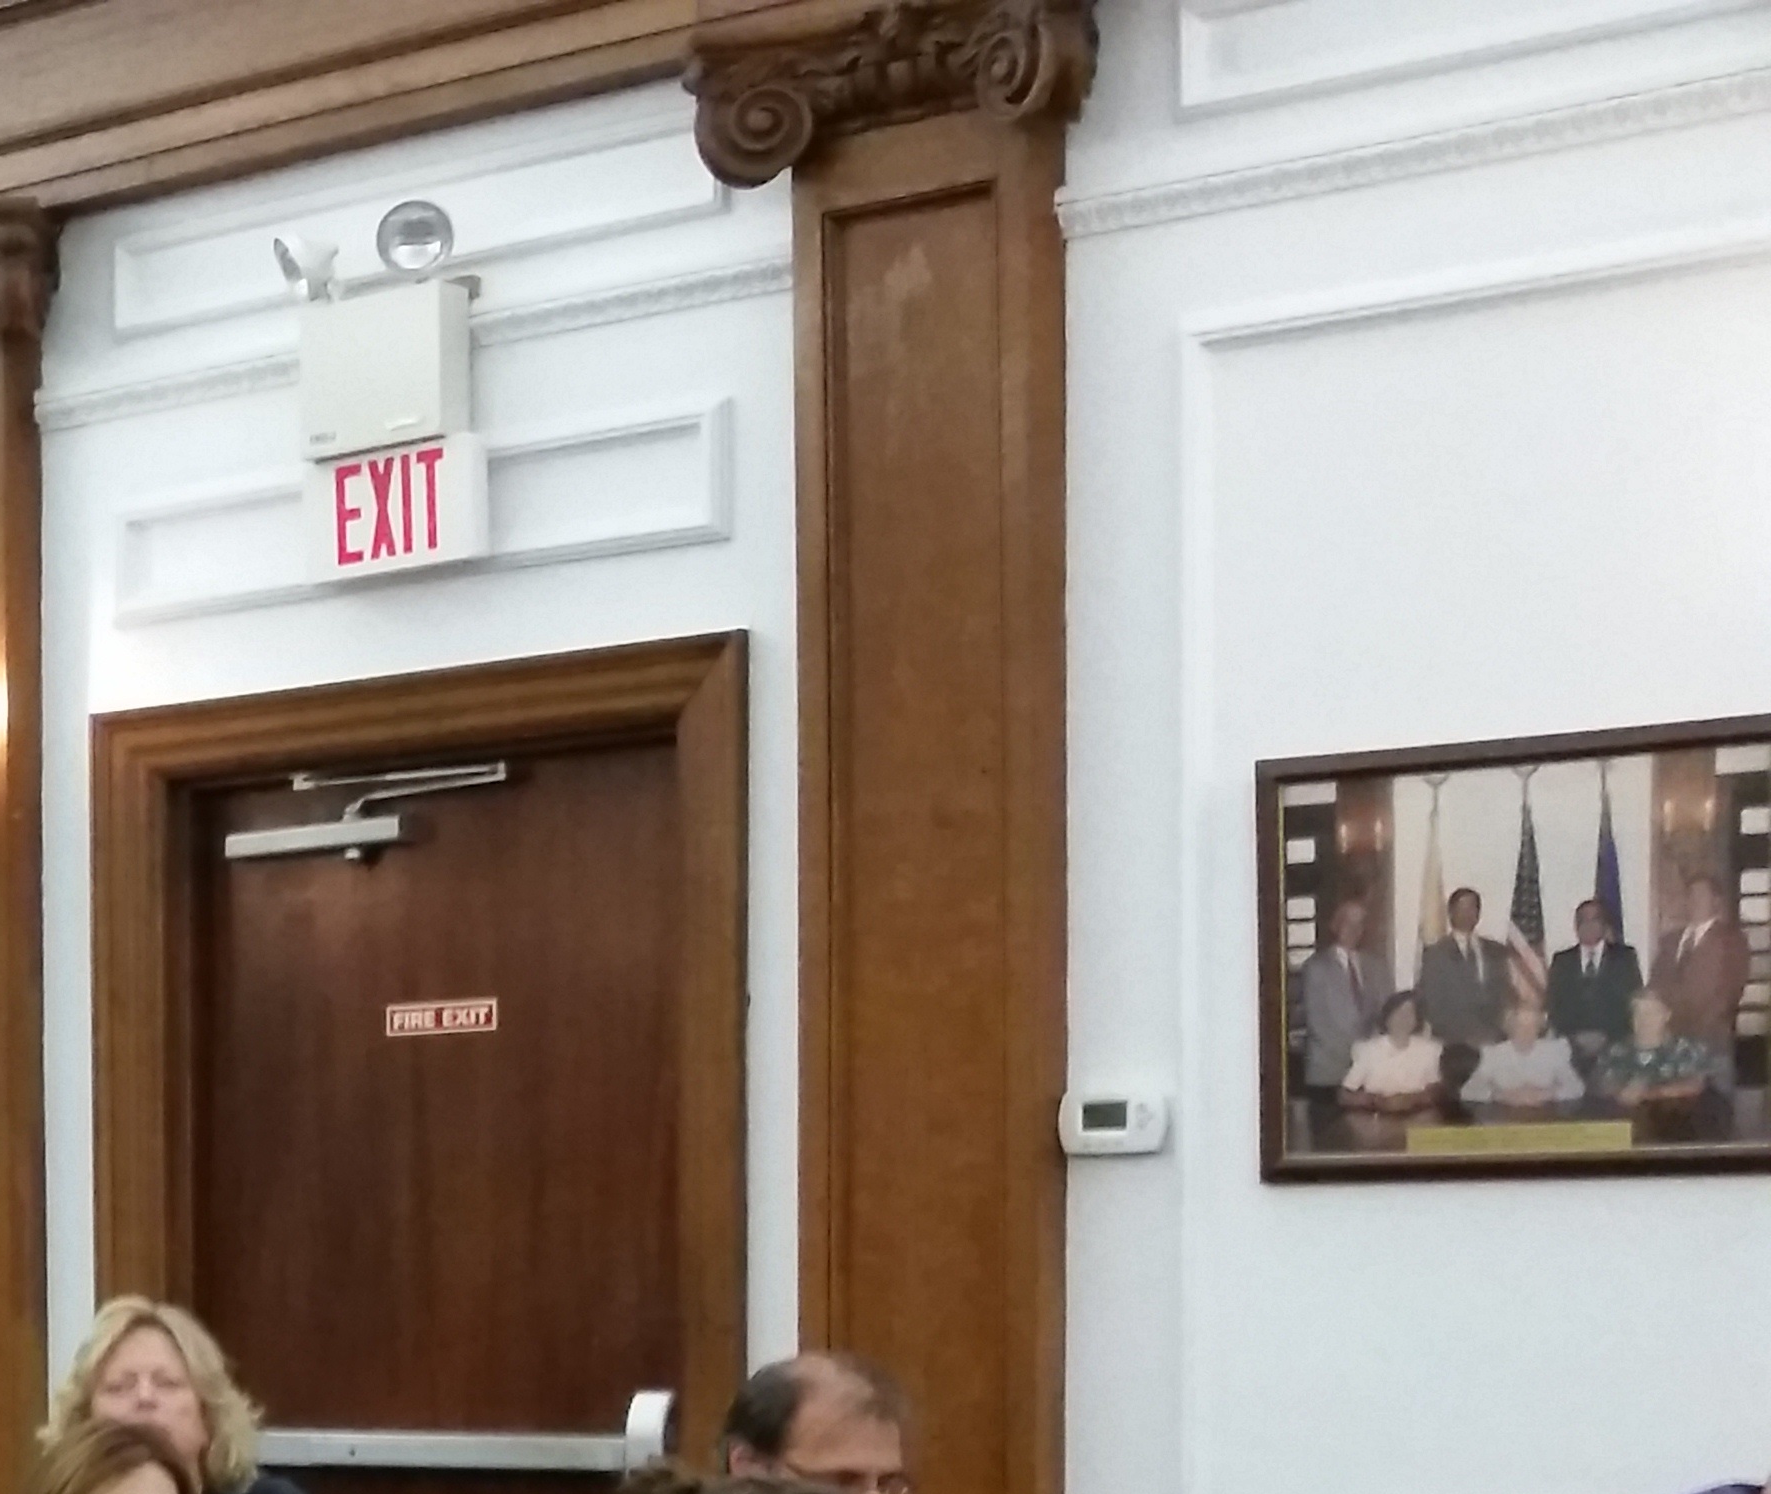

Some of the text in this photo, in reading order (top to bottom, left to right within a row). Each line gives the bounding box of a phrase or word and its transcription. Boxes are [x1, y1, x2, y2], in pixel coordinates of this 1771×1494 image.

[334, 447, 444, 566] EXIT
[393, 1005, 490, 1031] FIRE EXIT
